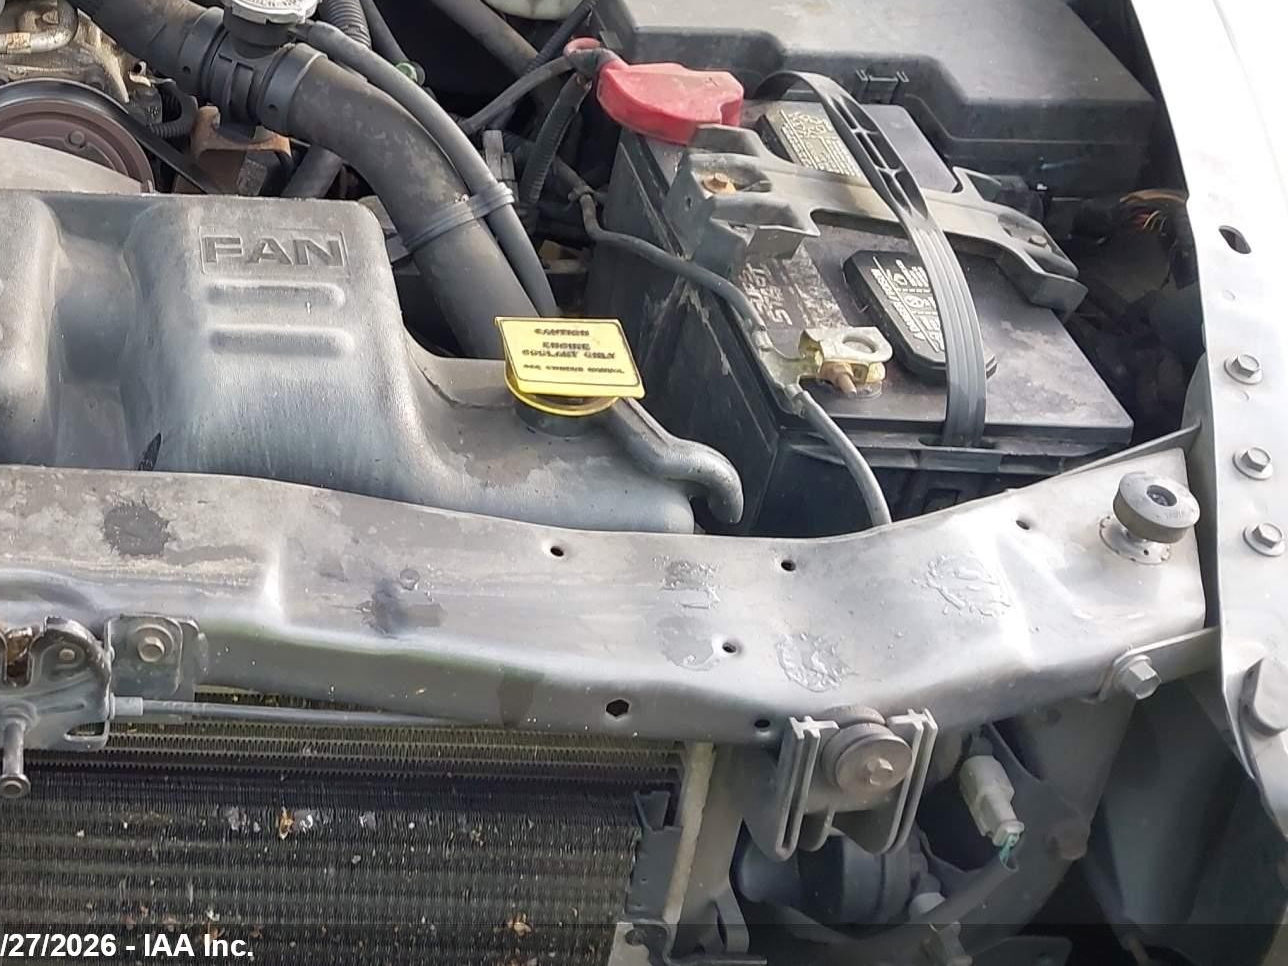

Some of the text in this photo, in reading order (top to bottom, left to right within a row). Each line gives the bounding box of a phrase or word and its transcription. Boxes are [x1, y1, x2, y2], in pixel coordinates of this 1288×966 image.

[202, 235, 344, 267] FAN
[534, 328, 590, 337] CAUTION
[542, 341, 591, 350] ENGINE
[521, 349, 616, 360] COOLANT ONLY
